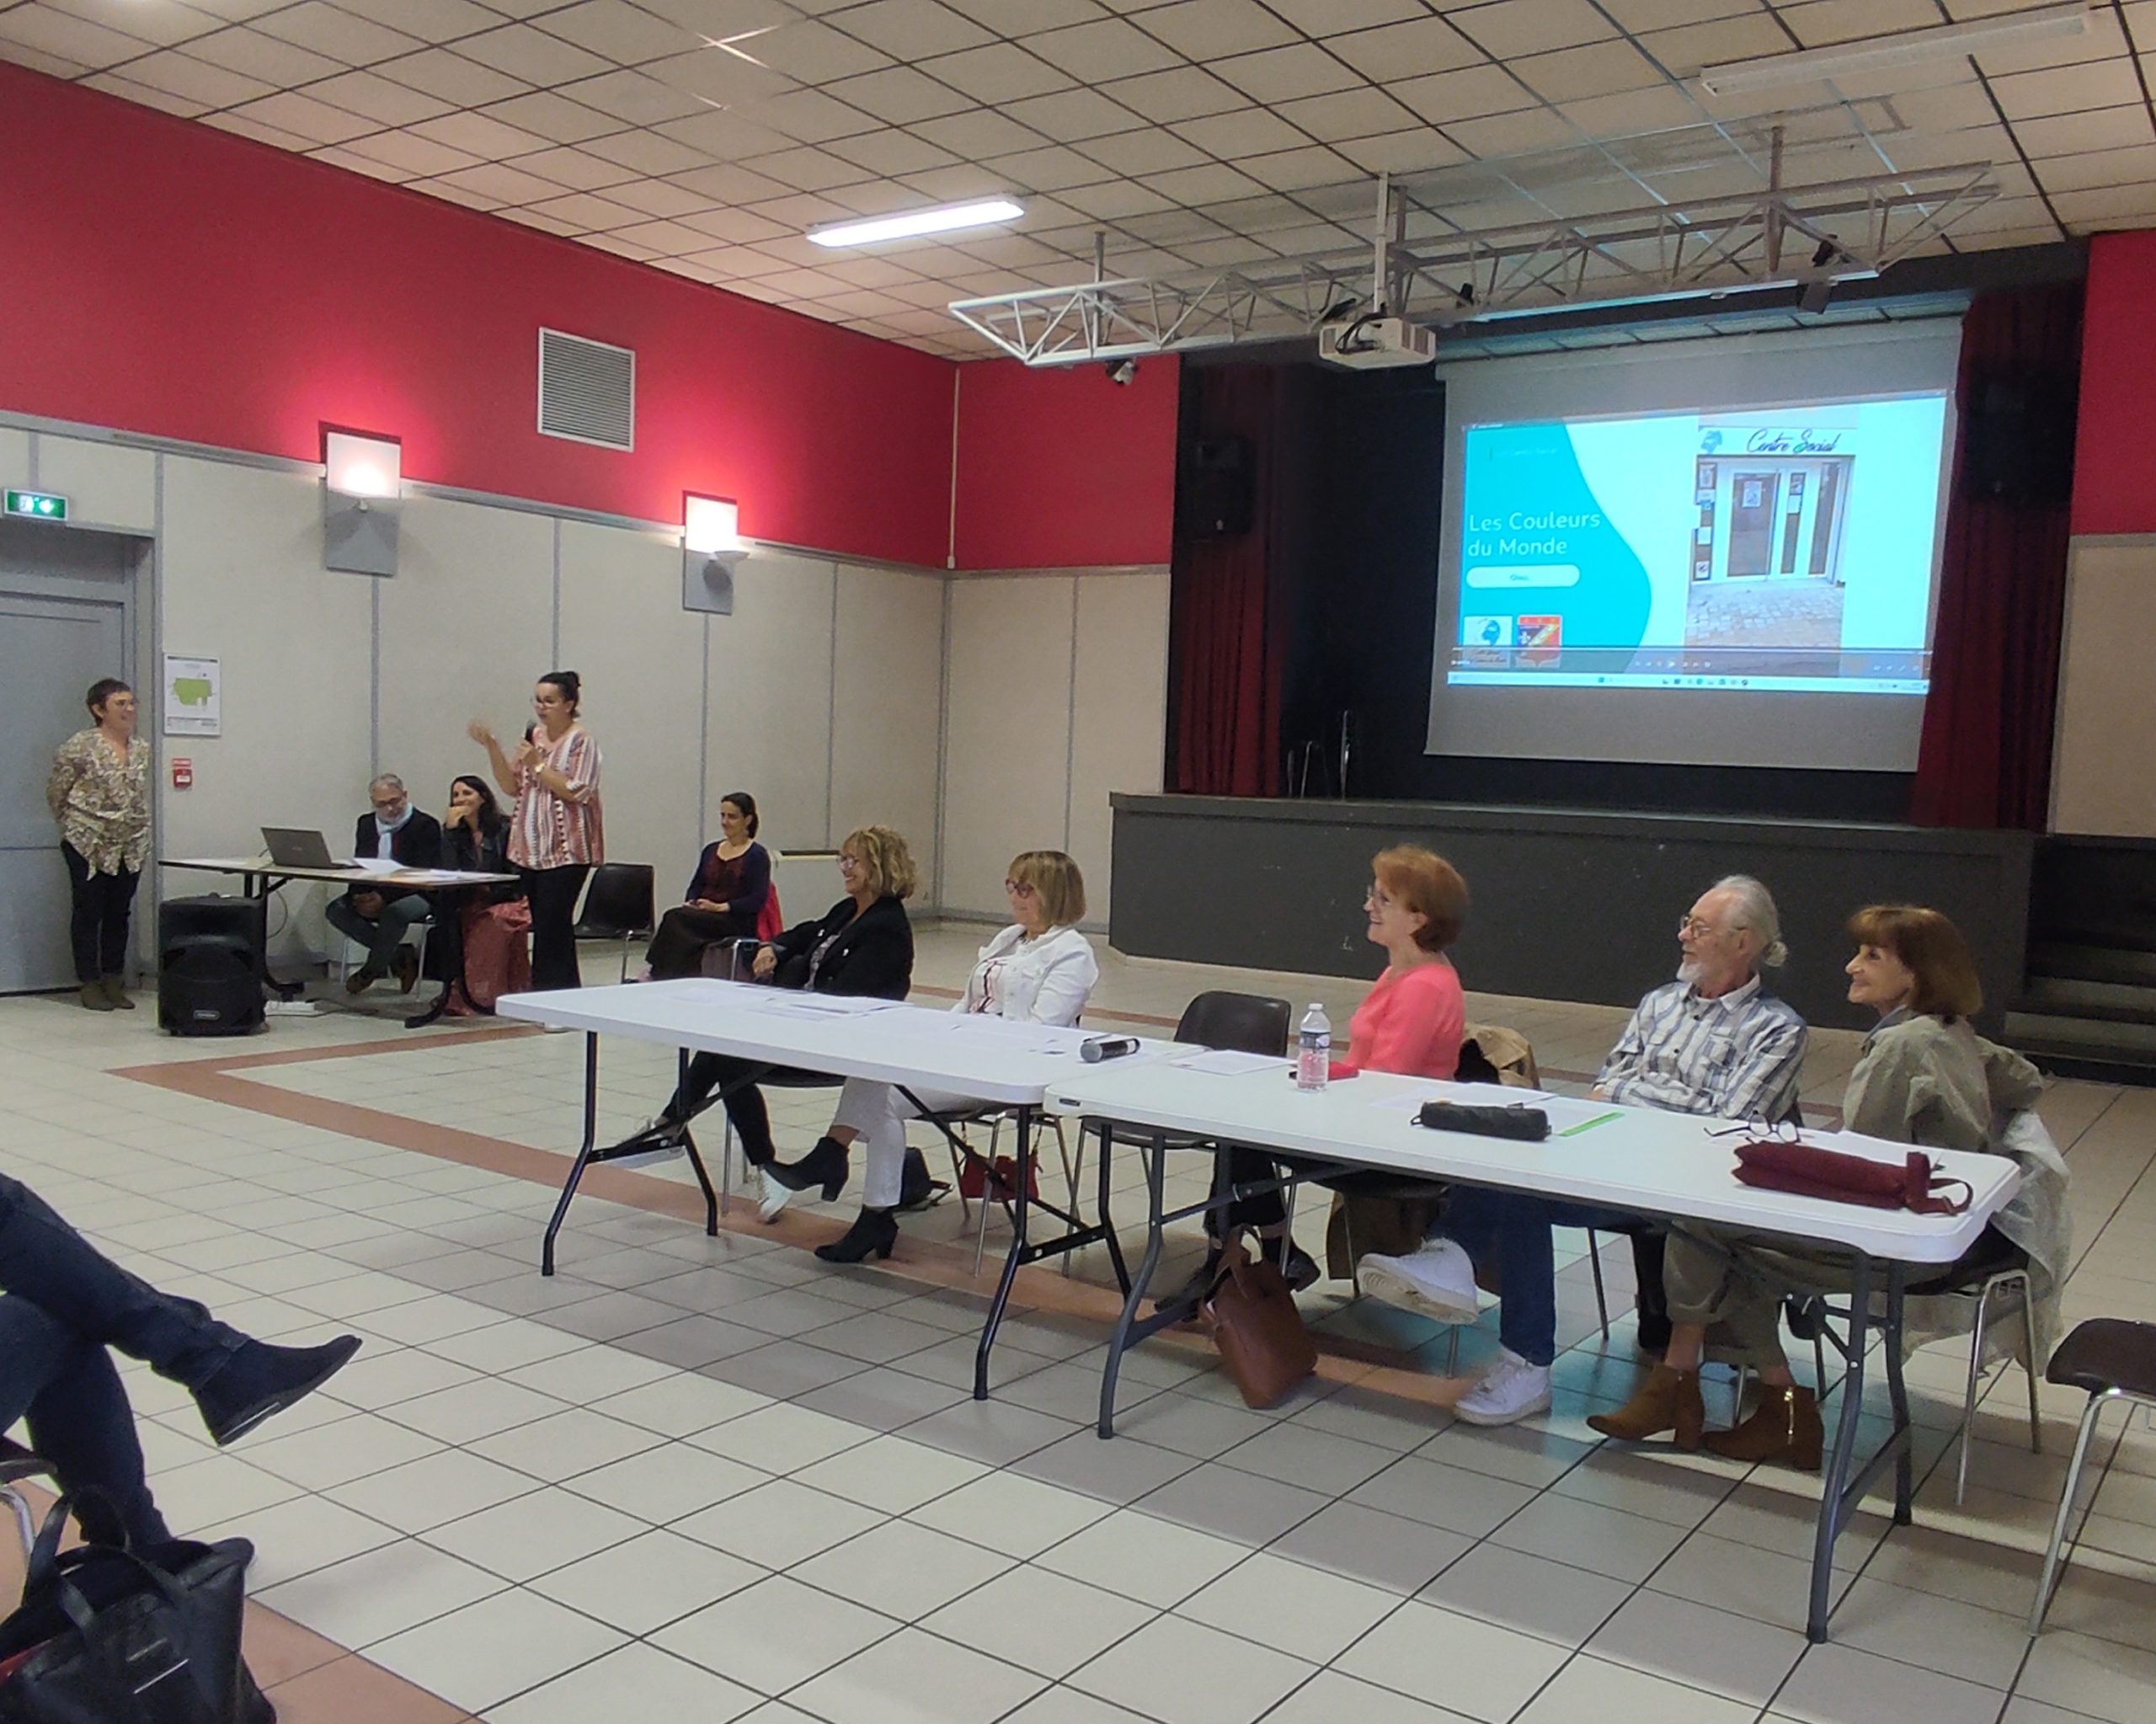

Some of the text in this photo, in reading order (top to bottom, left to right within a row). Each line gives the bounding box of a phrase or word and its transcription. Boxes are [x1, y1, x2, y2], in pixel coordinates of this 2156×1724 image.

[1747, 428, 1842, 453] Centre Social
[1469, 511, 1600, 532] Les Couleurs
[1468, 537, 1567, 557] du Monde
